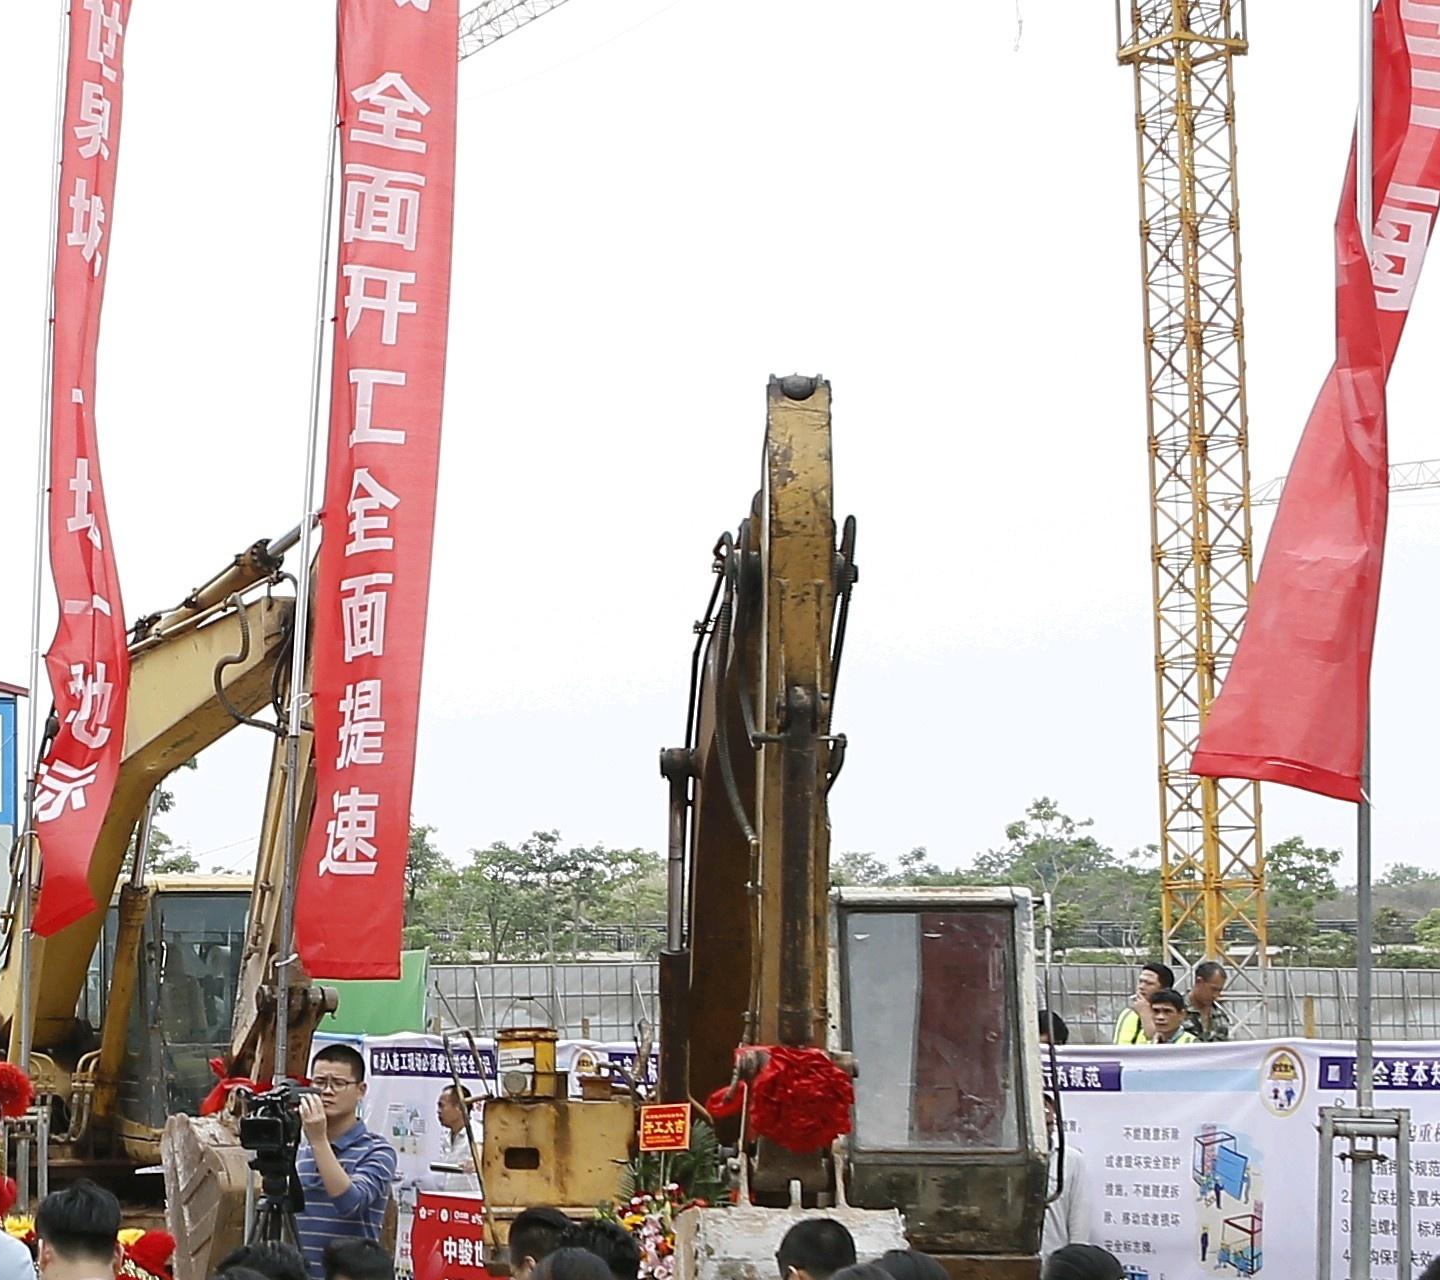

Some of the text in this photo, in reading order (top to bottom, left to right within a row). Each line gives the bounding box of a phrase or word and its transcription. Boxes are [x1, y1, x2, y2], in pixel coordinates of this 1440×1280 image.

[318, 71, 432, 877] 全面开工全面提速
